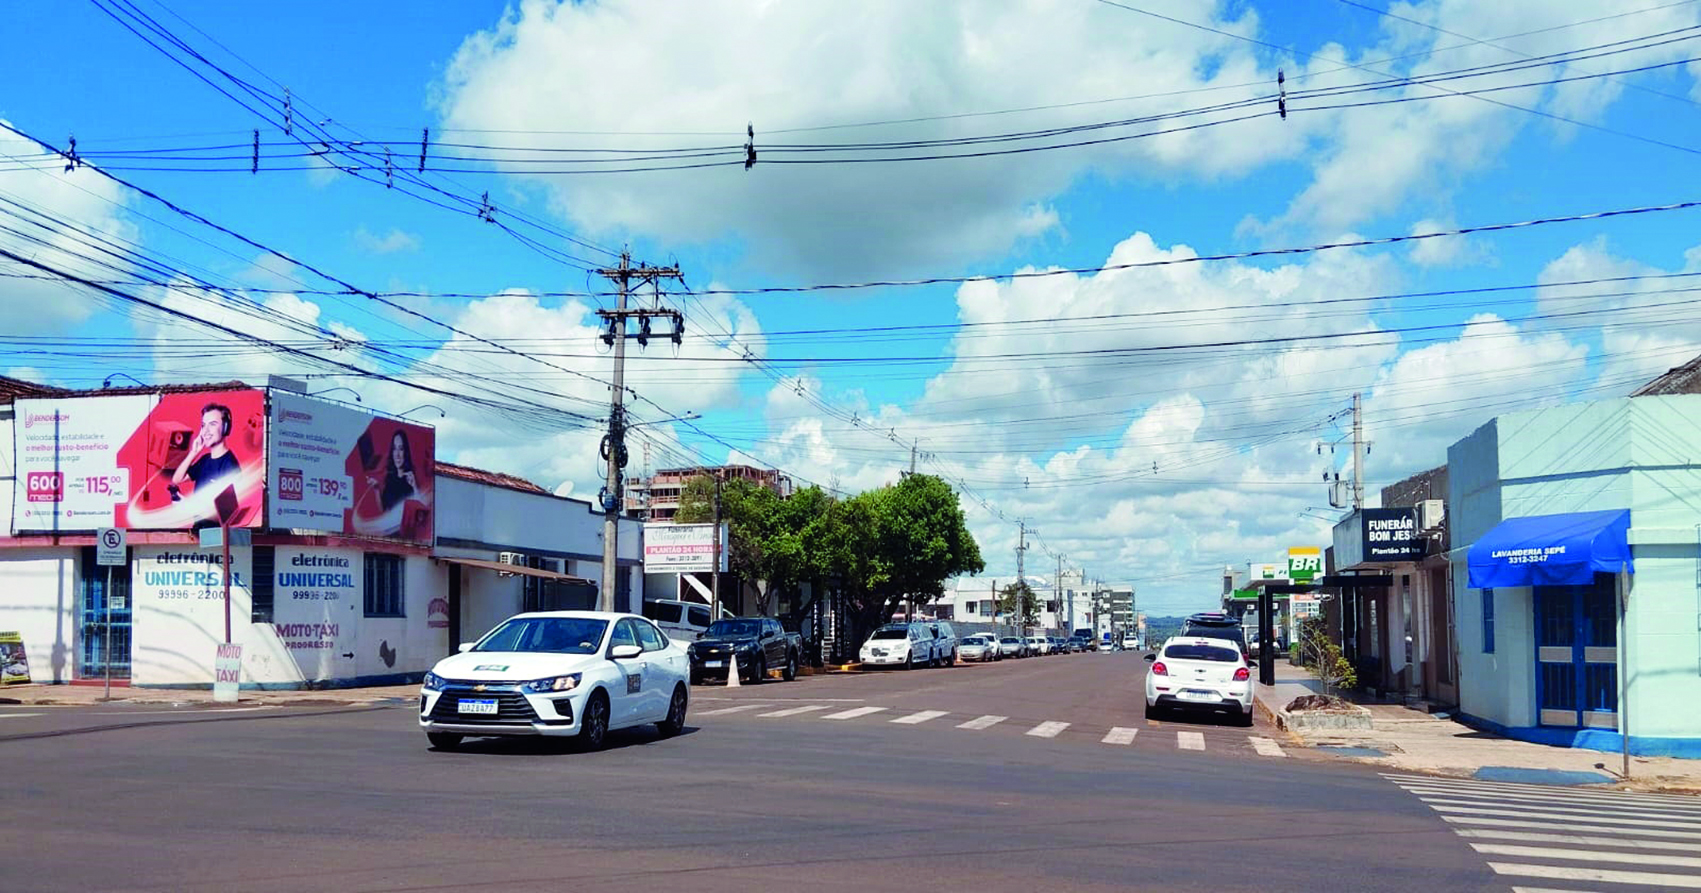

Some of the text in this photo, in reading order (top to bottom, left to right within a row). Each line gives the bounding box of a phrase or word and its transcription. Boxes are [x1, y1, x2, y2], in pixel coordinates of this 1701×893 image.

[30, 475, 60, 491] 600
[281, 476, 301, 492] 800
[1368, 515, 1413, 531] FUNERÁR
[1369, 530, 1391, 541] BOM
[650, 545, 682, 554] PLANTÃO
[693, 545, 713, 553] HORA
[1371, 547, 1400, 555] Plantão
[1491, 548, 1543, 558] LAVANDERIA
[1291, 558, 1319, 571] BR
[1508, 554, 1549, 564] 3312-3247
[144, 570, 247, 587] UNIVERSAL
[278, 572, 355, 588] UNIVERSAL
[276, 619, 339, 639] MOTO-TÁXI
[285, 640, 334, 649] PROGRESSO
[217, 645, 241, 660] MOTO
